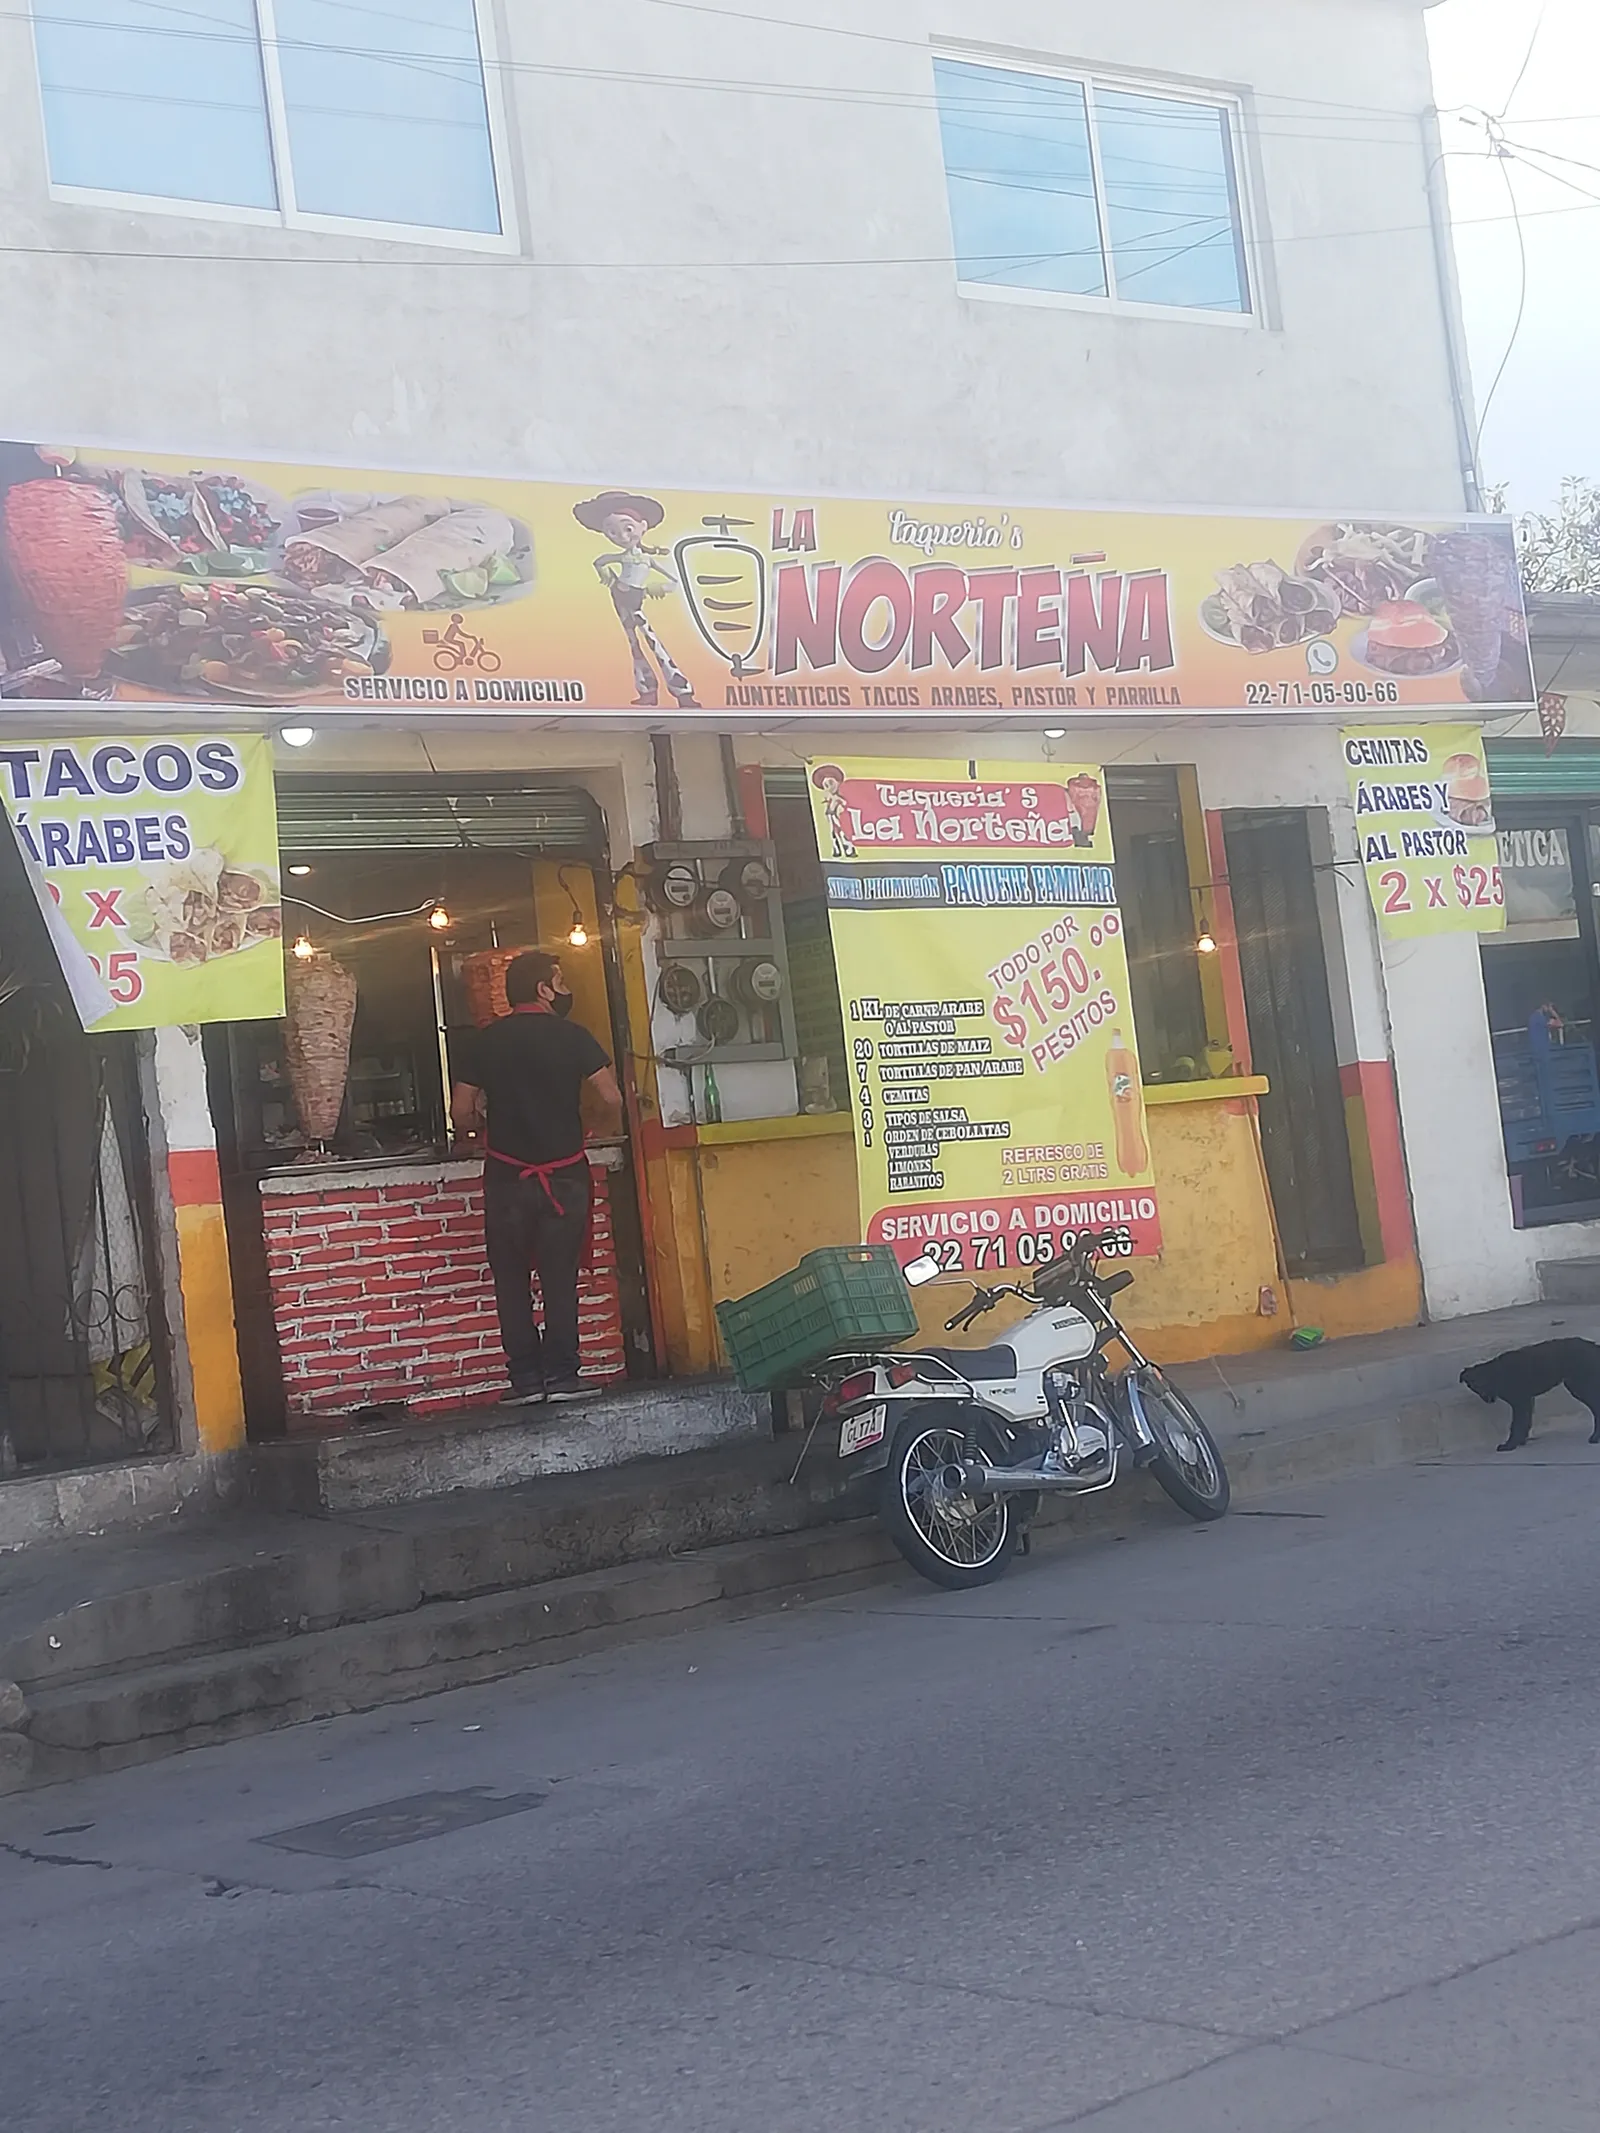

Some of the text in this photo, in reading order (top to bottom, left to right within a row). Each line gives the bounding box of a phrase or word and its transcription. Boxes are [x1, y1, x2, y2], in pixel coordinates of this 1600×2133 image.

[772, 507, 817, 551] LA
[770, 551, 1176, 677] NORTEÑA
[346, 677, 584, 701] SERVICIO A DOMICILIO
[726, 685, 1181, 709] AUNTENTICOS TACOS ARABES, PASTOR Y PARRILLA
[1246, 682, 1398, 705] 22-71-05-90-66
[1345, 739, 1429, 765] CEMITAS
[0, 742, 240, 799] TACOS
[1356, 782, 1449, 814] ÁRABES Y
[847, 808, 1075, 845] La Norteña
[1366, 830, 1468, 863] AL PASTOR
[941, 864, 1031, 906] PAQUETE
[1031, 866, 1117, 905] FAMILIAR
[1379, 871, 1411, 913] 2
[1453, 864, 1505, 909] $25
[987, 915, 1080, 990] TODO POR
[851, 1002, 859, 1019] 1
[885, 1005, 900, 1019] DE
[901, 1003, 940, 1018] CARNE
[941, 1001, 984, 1017] ARABE
[911, 1020, 955, 1034] PASTOR
[1031, 990, 1117, 1072] PESITOS
[855, 1039, 991, 1058] 20 TORTILLAS DE MAIZ
[857, 1059, 1023, 1081] 7 TORTILLAS DE PAN ARABE
[860, 1087, 929, 1104] 4 CEMITAS
[862, 1108, 968, 1128] 3 TIPOS DE SALSA
[864, 1123, 1010, 1146] 1 ORDEN DE CEBOLLITAS
[889, 1143, 939, 1159] VERDURAS
[1002, 1143, 1104, 1165] REFRESCO DE
[889, 1159, 932, 1175] LIMONES
[1003, 1163, 1108, 1185] 2 LTRS GRATIS
[889, 1173, 943, 1191] RABANITOS
[881, 1198, 1156, 1241] SERVICIO A DOMICILIO
[923, 1239, 963, 1271] 22
[969, 1235, 1006, 1269] 71
[1017, 1233, 1053, 1265] 05
